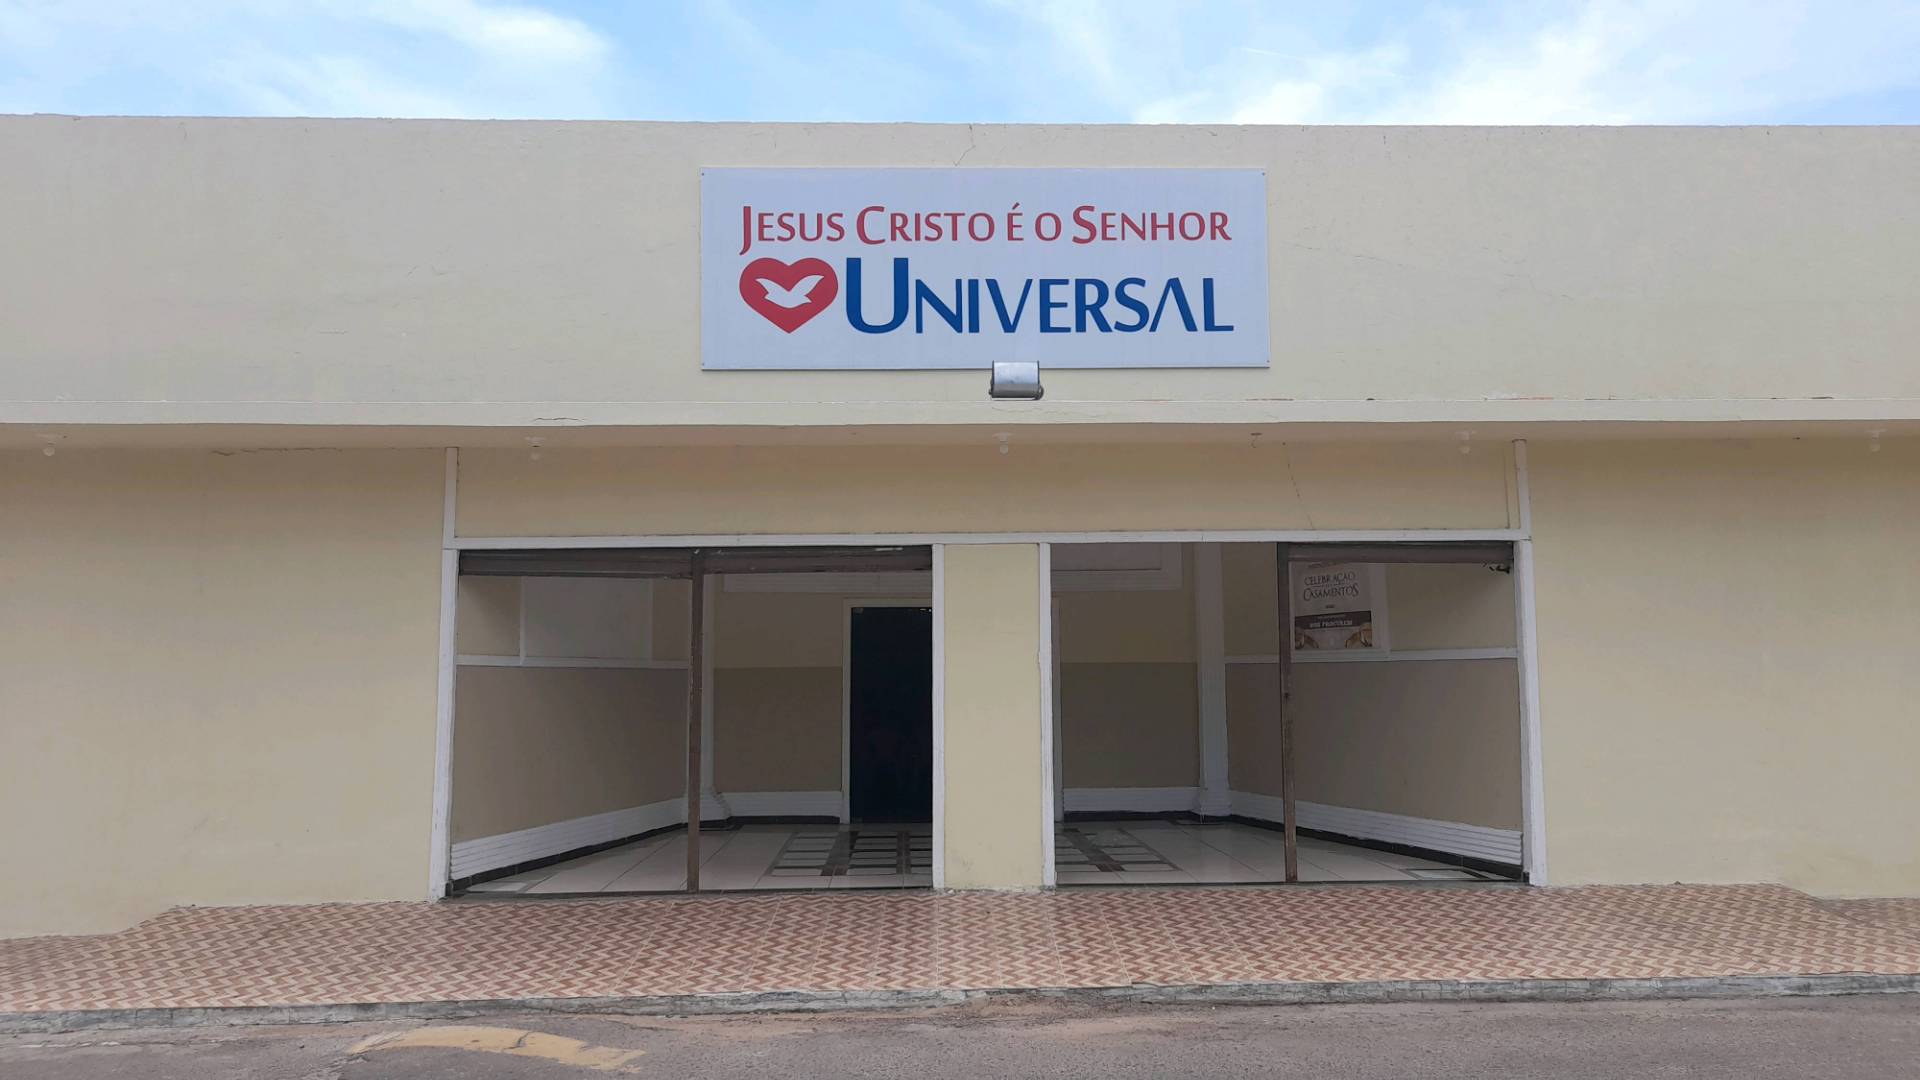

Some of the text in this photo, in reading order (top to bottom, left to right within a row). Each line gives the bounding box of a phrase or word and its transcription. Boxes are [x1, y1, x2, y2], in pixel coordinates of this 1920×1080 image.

[740, 202, 1233, 255] JESUS CRISTO É O SENHOR
[845, 257, 1235, 335] UNIVERSAL
